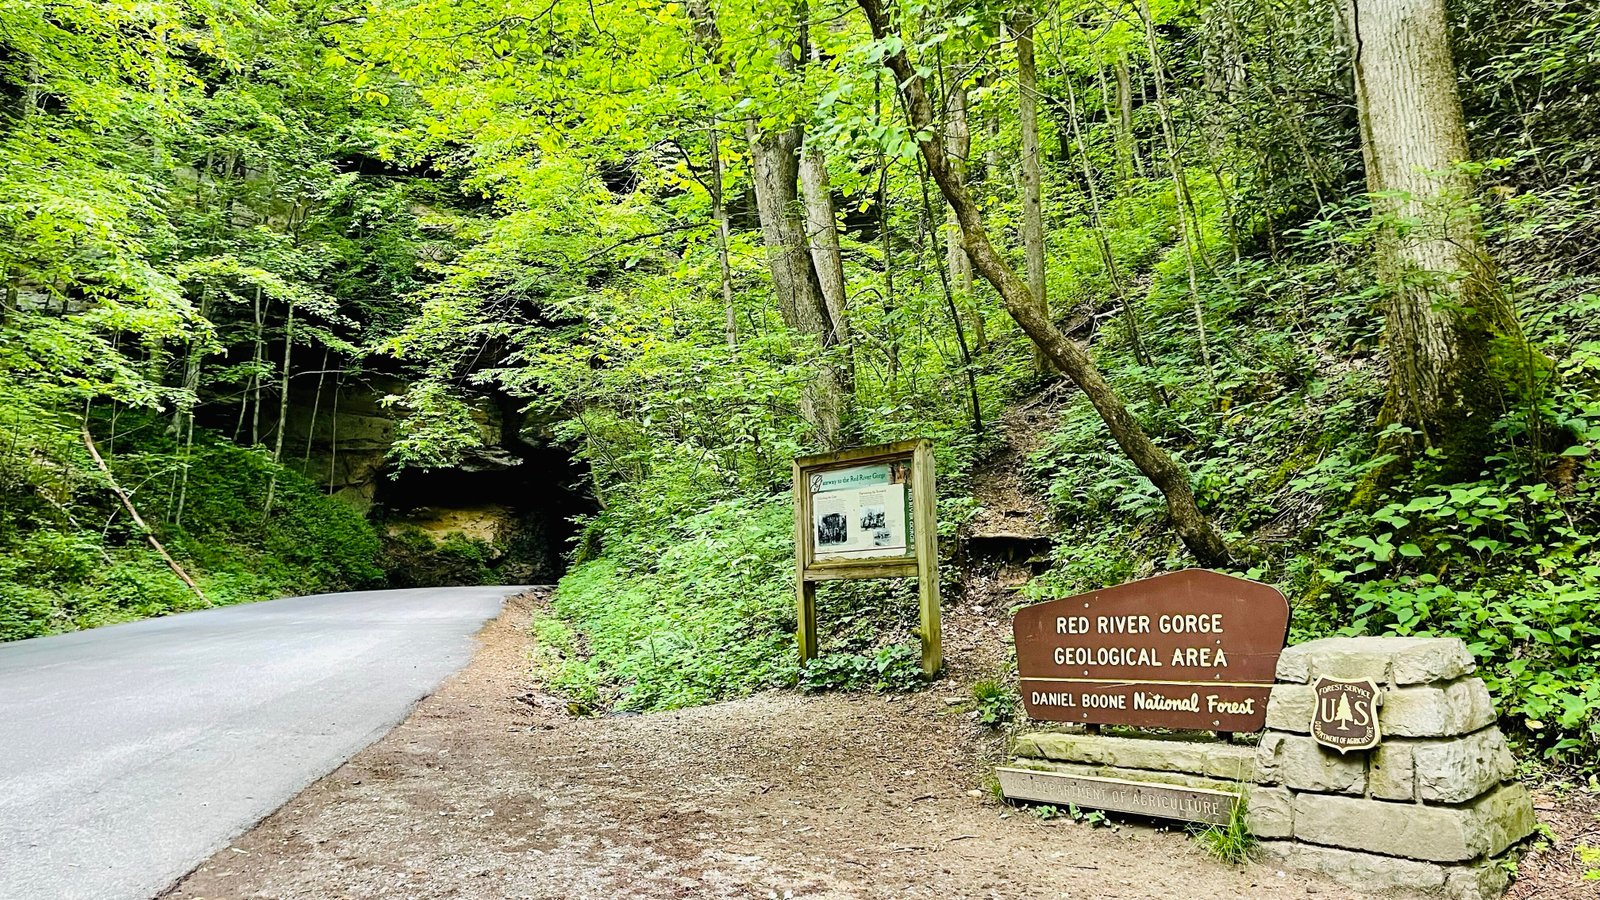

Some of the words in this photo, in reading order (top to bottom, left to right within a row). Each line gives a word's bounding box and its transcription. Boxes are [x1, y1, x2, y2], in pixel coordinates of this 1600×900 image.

[872, 472, 886, 480] Gorge
[1056, 616, 1090, 634] RED
[1097, 615, 1150, 634] RIVER
[1158, 613, 1224, 634] GORGE
[1054, 647, 1163, 667] GEOLOGICAL
[1171, 647, 1228, 667] AREA
[1318, 684, 1343, 696] FOREST
[1344, 684, 1371, 699] SERVICE
[1031, 691, 1076, 707] DANIEL
[1081, 693, 1126, 709] BOONE
[1133, 691, 1200, 713] National
[1206, 694, 1255, 715] Forest
[1314, 720, 1339, 743] DEPARTMENT
[1346, 726, 1374, 744] AGRICULTURE
[1035, 779, 1107, 800] DEPARTMENT
[1112, 790, 1126, 803] OF
[1132, 793, 1220, 816] AGRICULTURE
